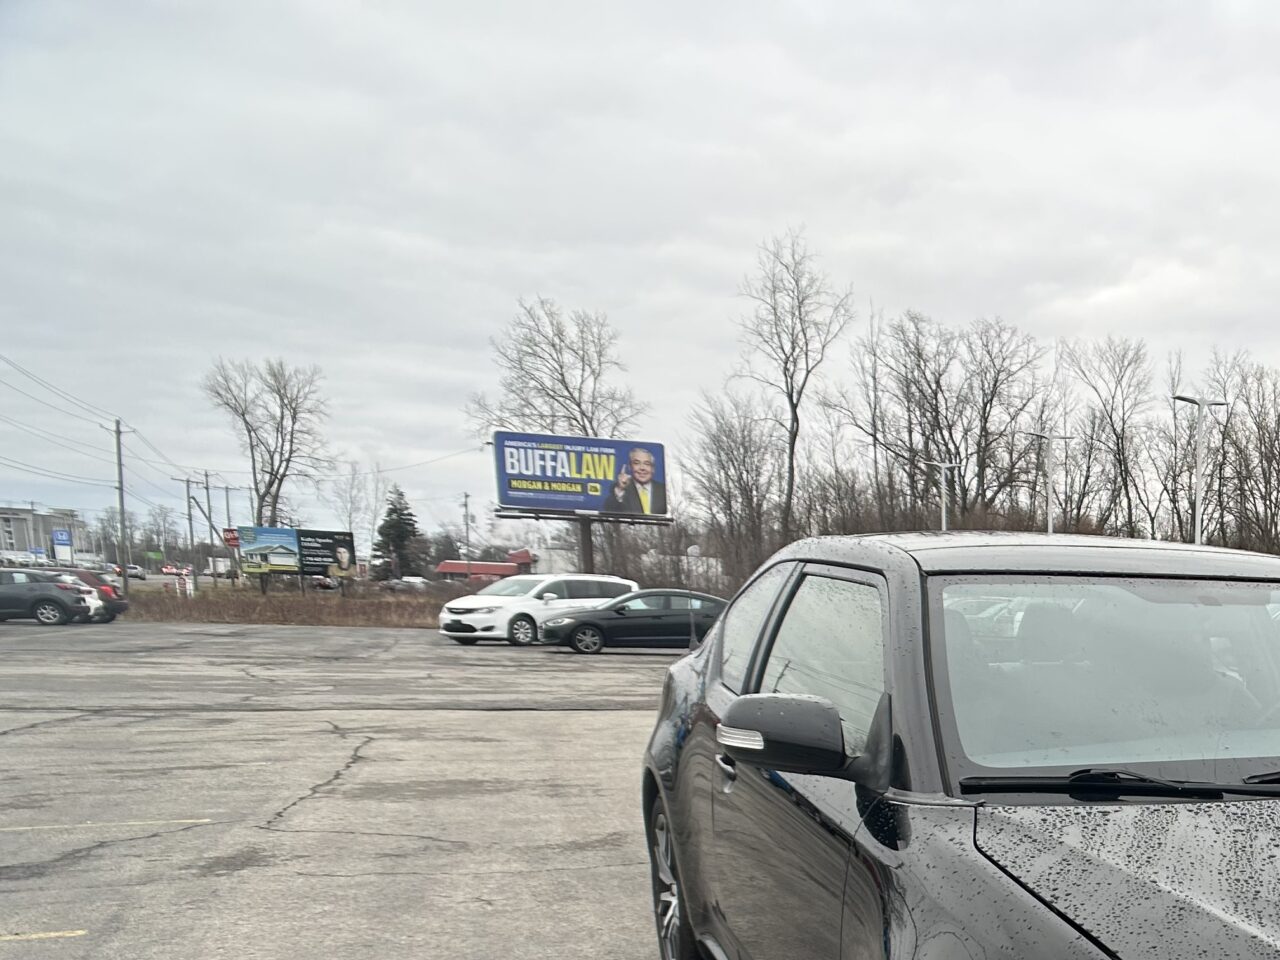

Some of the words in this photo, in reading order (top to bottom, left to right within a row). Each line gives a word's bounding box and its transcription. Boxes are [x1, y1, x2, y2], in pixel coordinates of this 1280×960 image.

[504, 447, 615, 480] BUFFALAW
[510, 480, 542, 490] MORGAN
[551, 482, 582, 492] MORGAN
